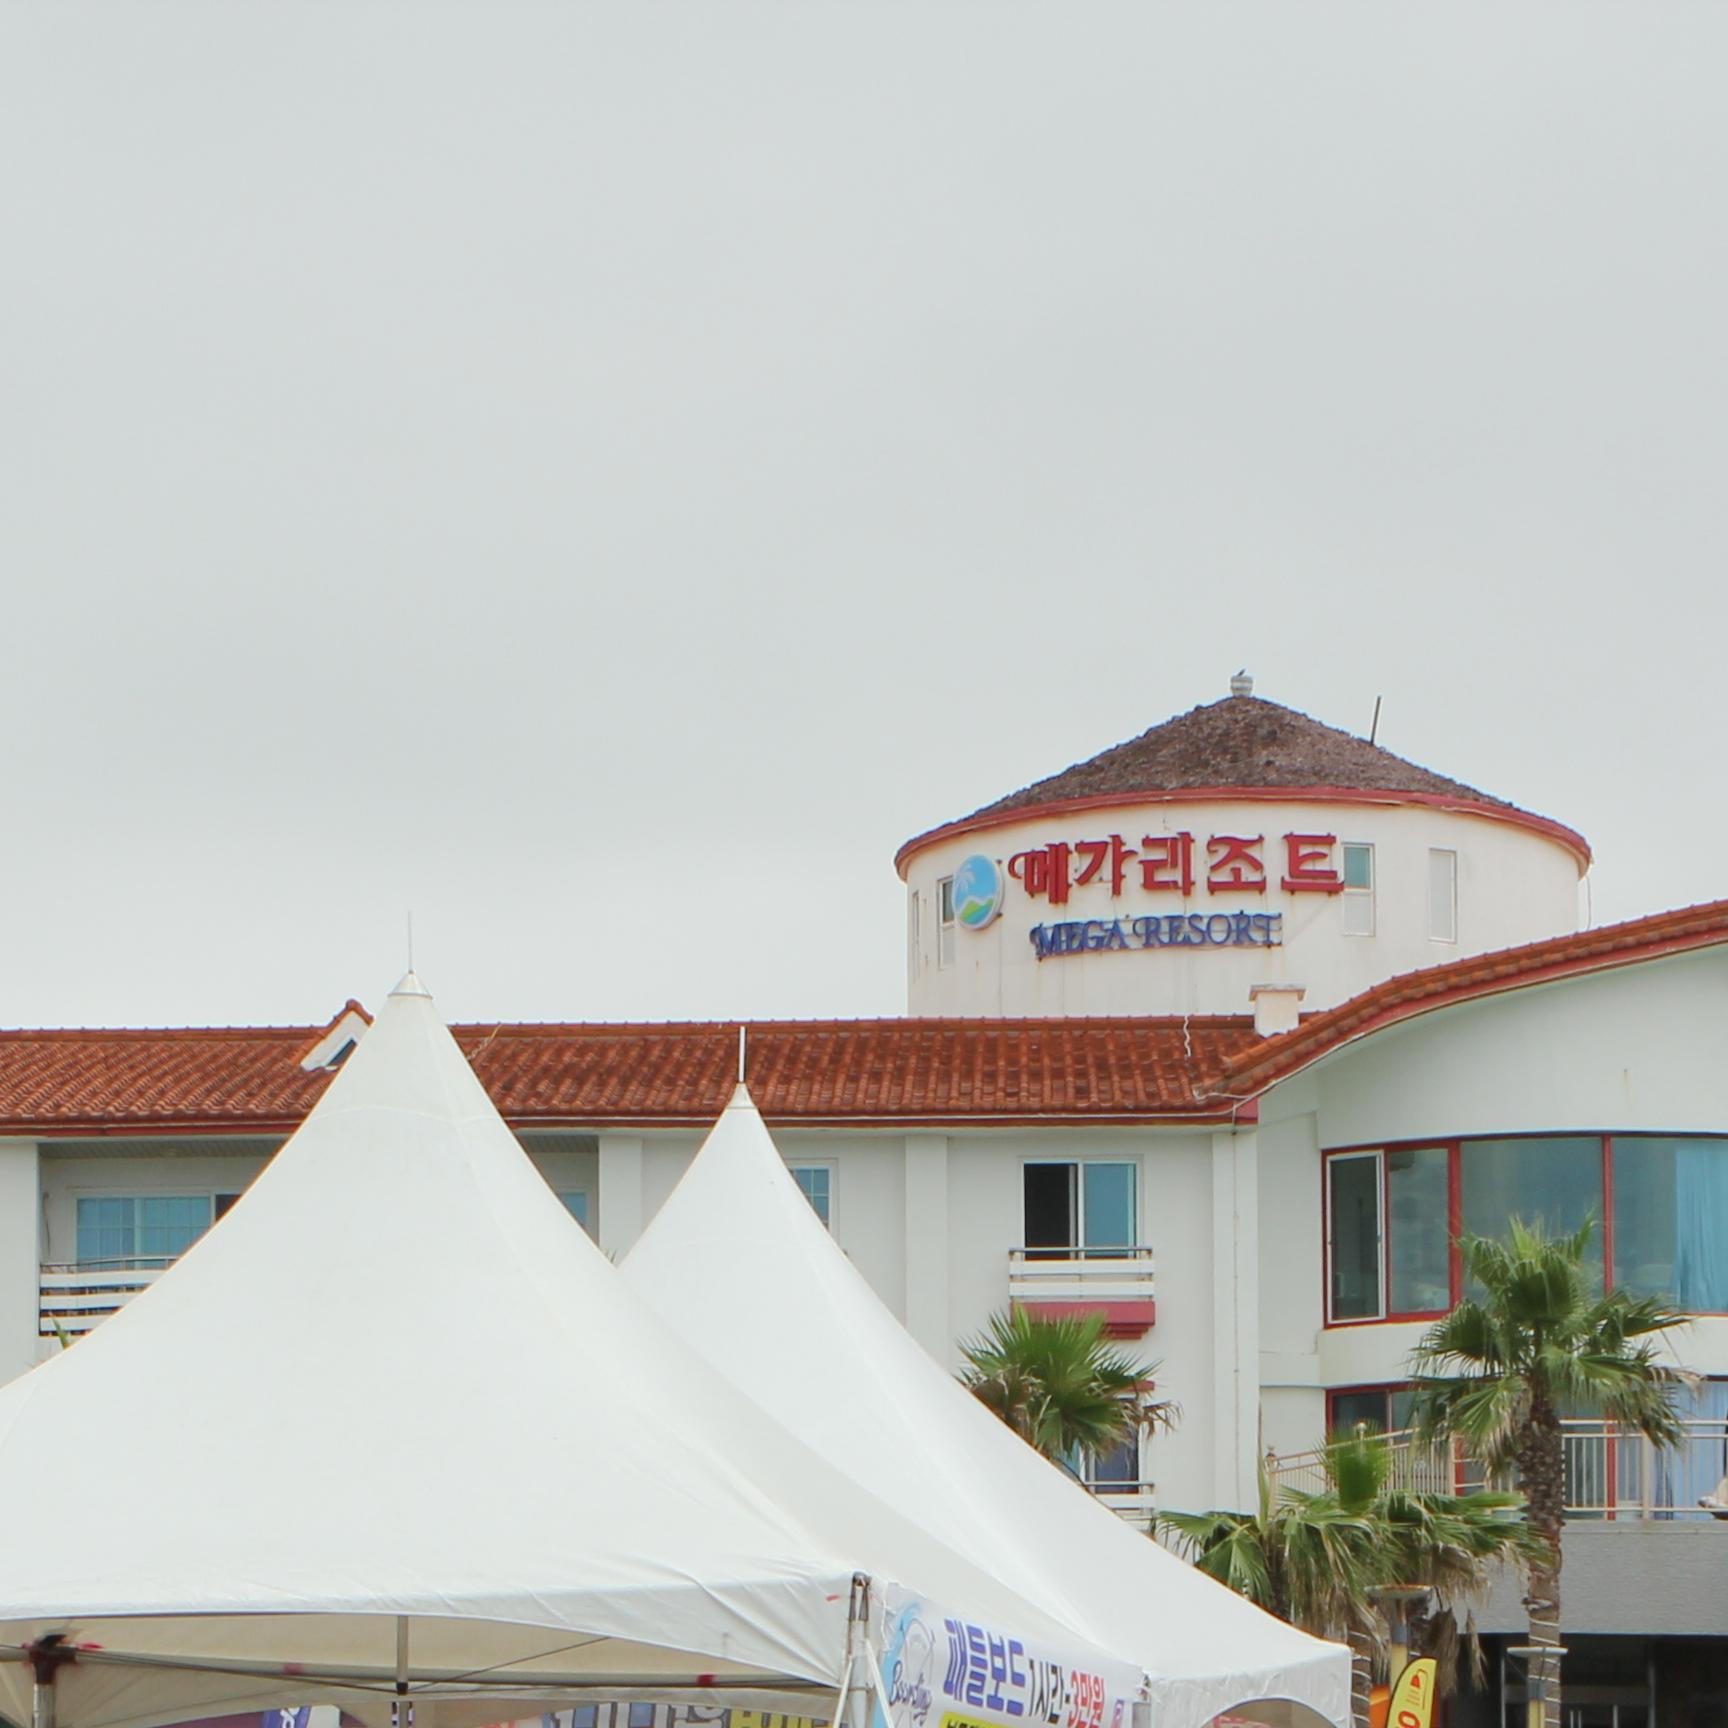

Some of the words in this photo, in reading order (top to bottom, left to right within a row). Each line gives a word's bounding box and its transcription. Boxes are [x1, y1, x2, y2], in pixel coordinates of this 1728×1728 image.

[1008, 832, 1345, 904] 메가리조트
[1030, 920, 1126, 957] MEGA
[1134, 912, 1279, 947] RESORT
[943, 1617, 1026, 1717] 패들보드
